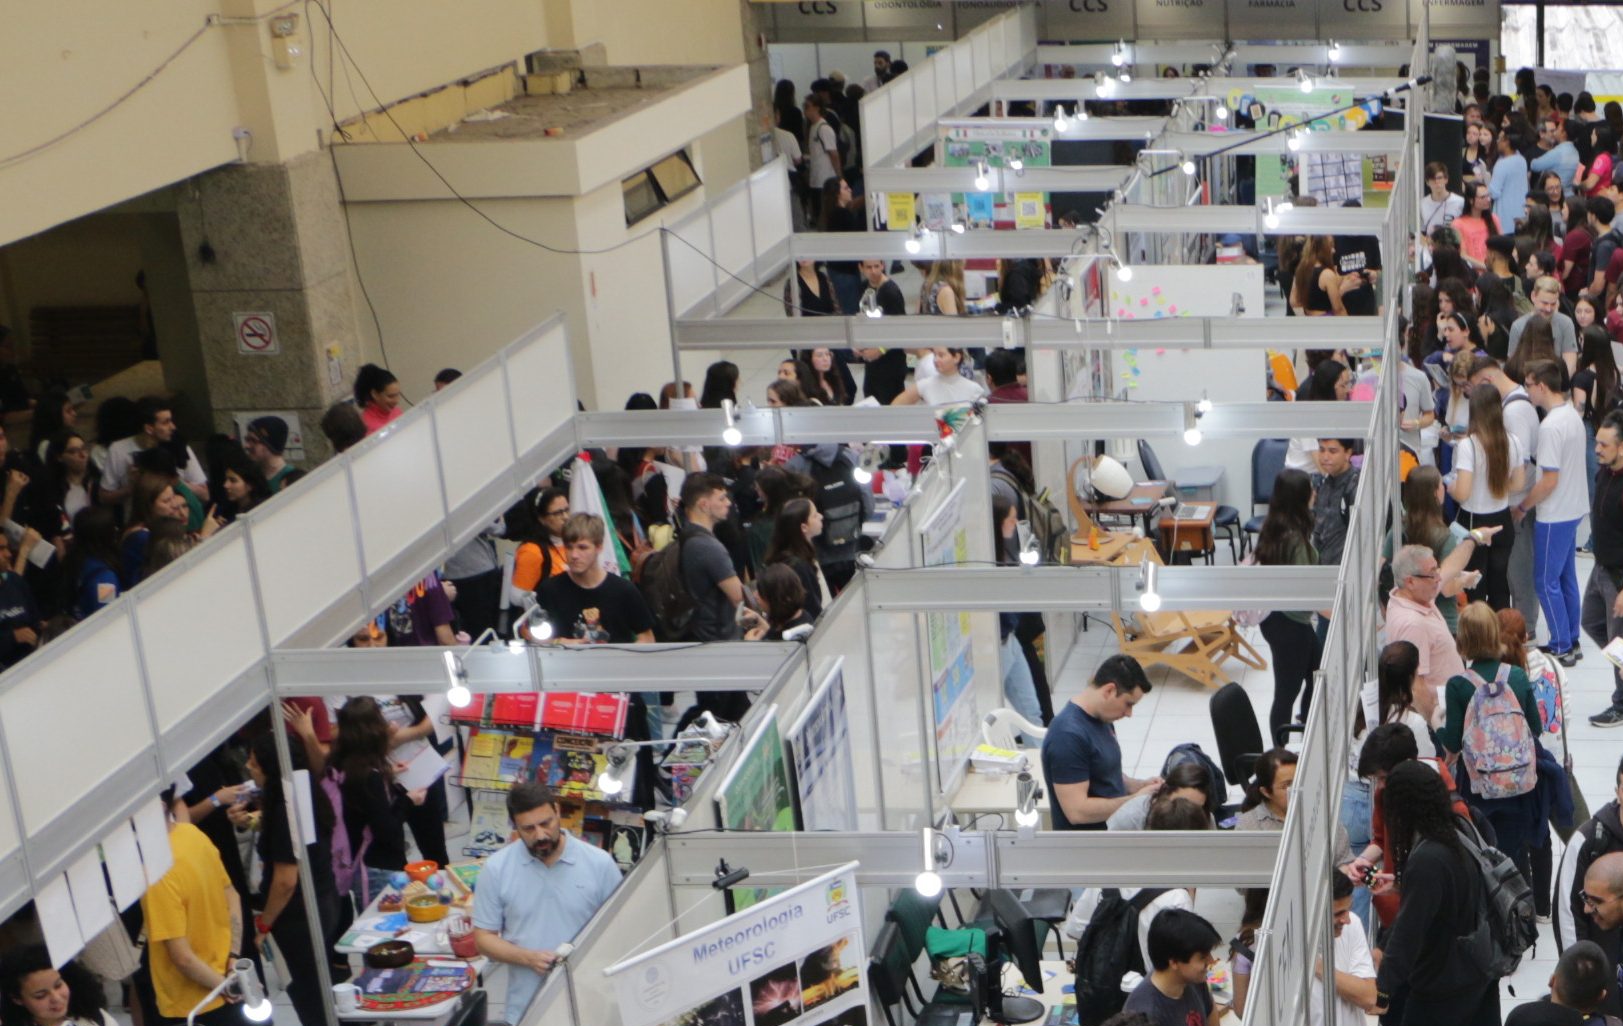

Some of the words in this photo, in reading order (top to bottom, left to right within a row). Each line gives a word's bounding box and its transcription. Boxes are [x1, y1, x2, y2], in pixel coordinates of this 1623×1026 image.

[692, 901, 804, 964] Meteorologia
[825, 904, 852, 925] UFSC
[727, 941, 777, 978] UFSC
